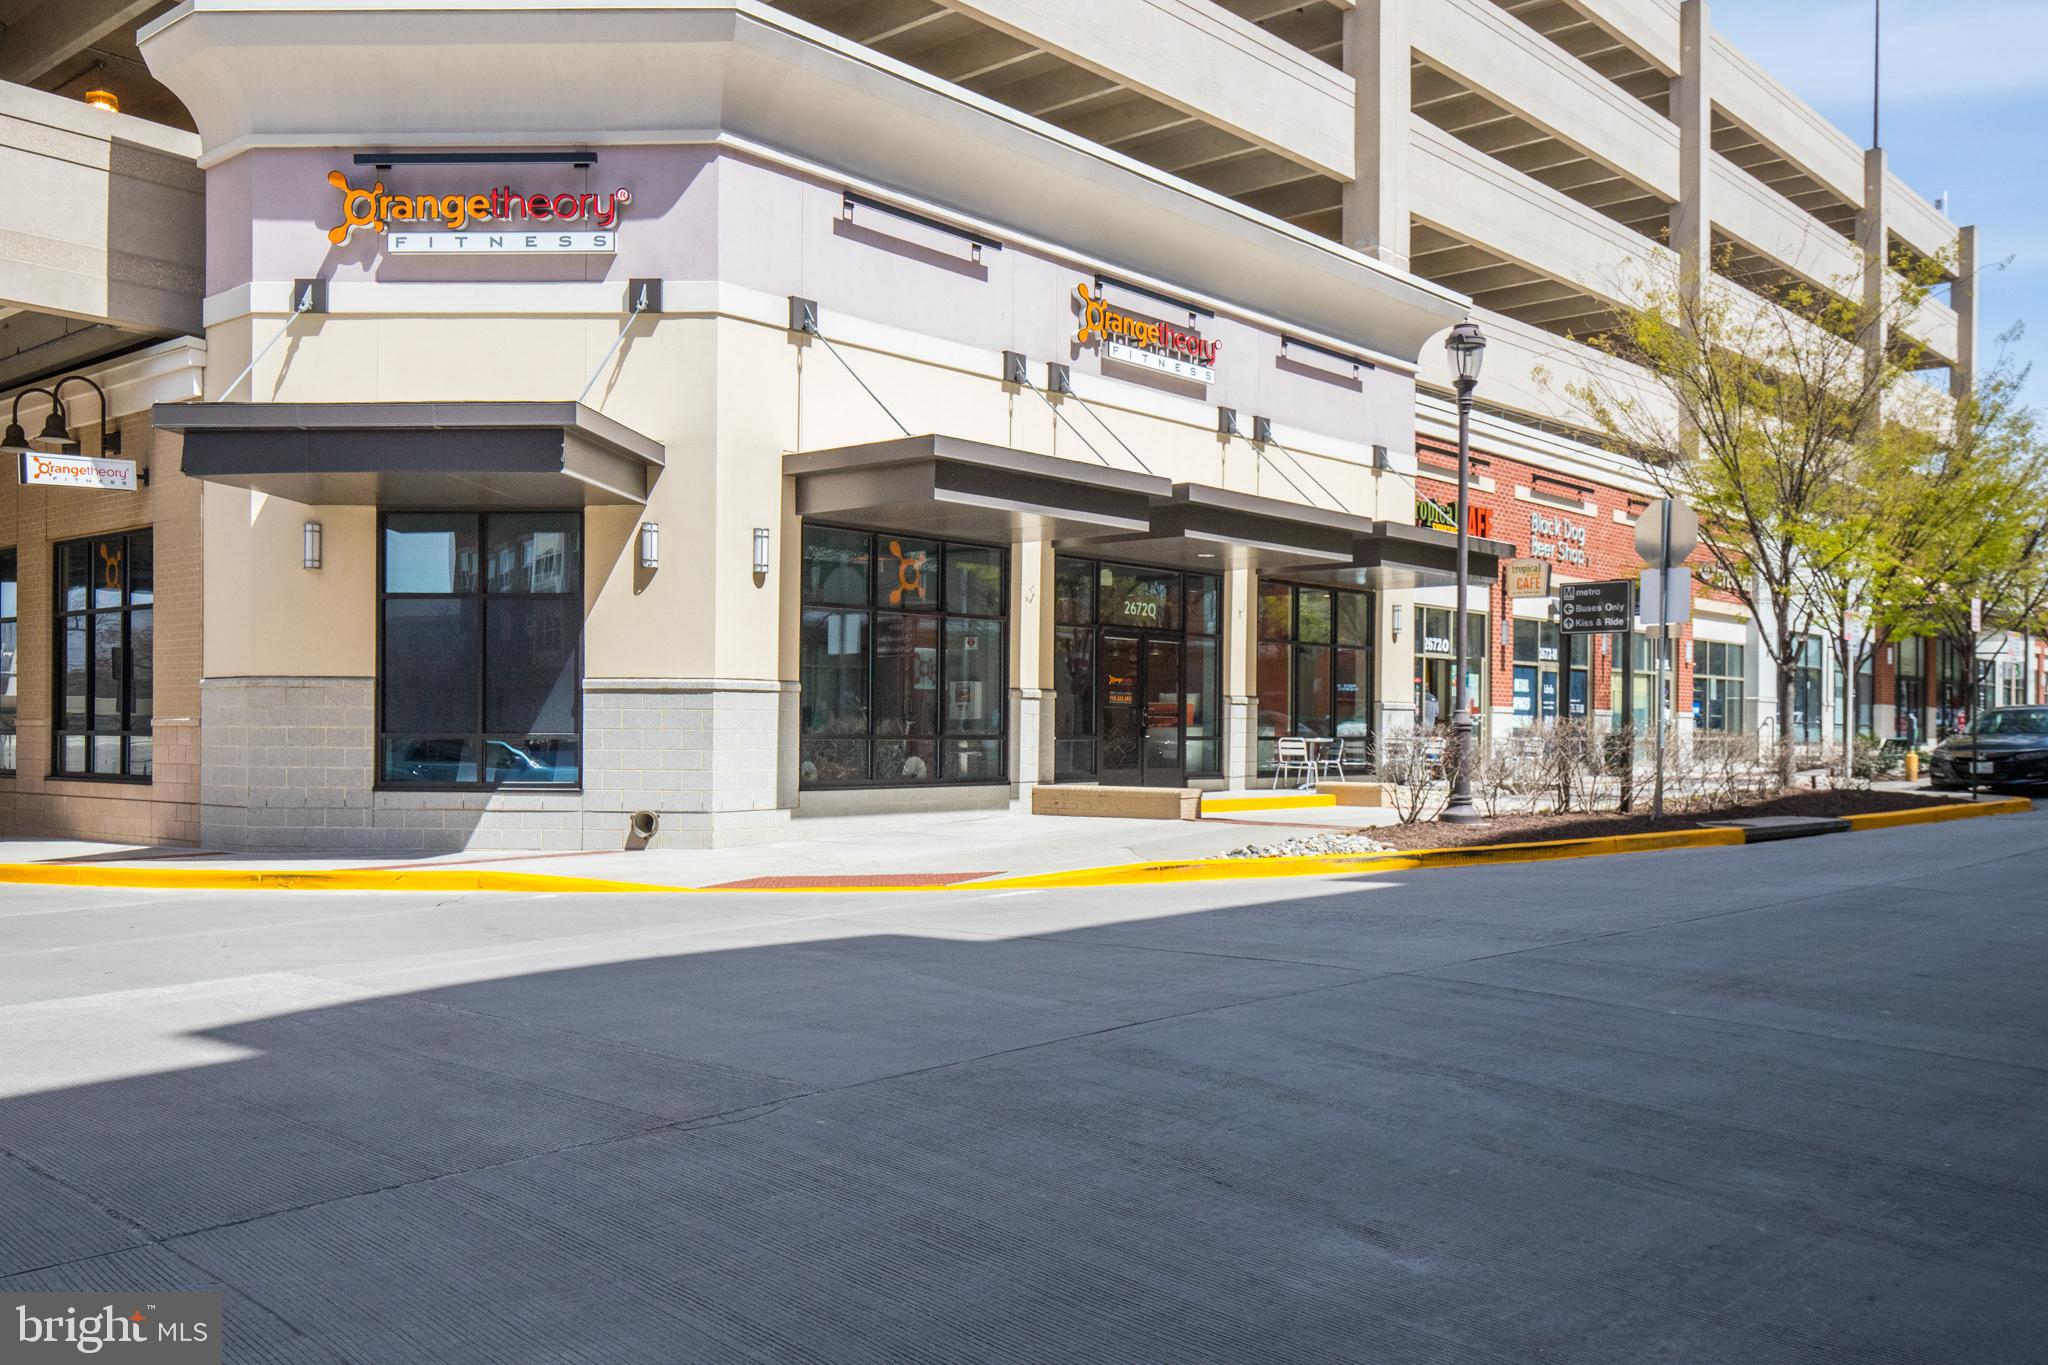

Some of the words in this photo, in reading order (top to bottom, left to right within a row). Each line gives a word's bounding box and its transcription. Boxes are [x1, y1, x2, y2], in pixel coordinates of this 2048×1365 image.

[395, 235, 607, 249] FITNESS
[1112, 346, 1212, 381] FITNESS
[1467, 506, 1493, 538] AFE
[1532, 512, 1561, 536] Black
[1564, 519, 1585, 547] Dog
[1532, 535, 1556, 558] Beer
[1558, 541, 1585, 566] Shop
[1512, 562, 1541, 575] tropical
[1516, 576, 1541, 590] CAFE
[1576, 588, 1600, 596] metro
[1124, 600, 1157, 620] 2672Q
[1576, 604, 1602, 612] Buses
[1604, 603, 1625, 612] Only
[1604, 617, 1624, 626] Ride
